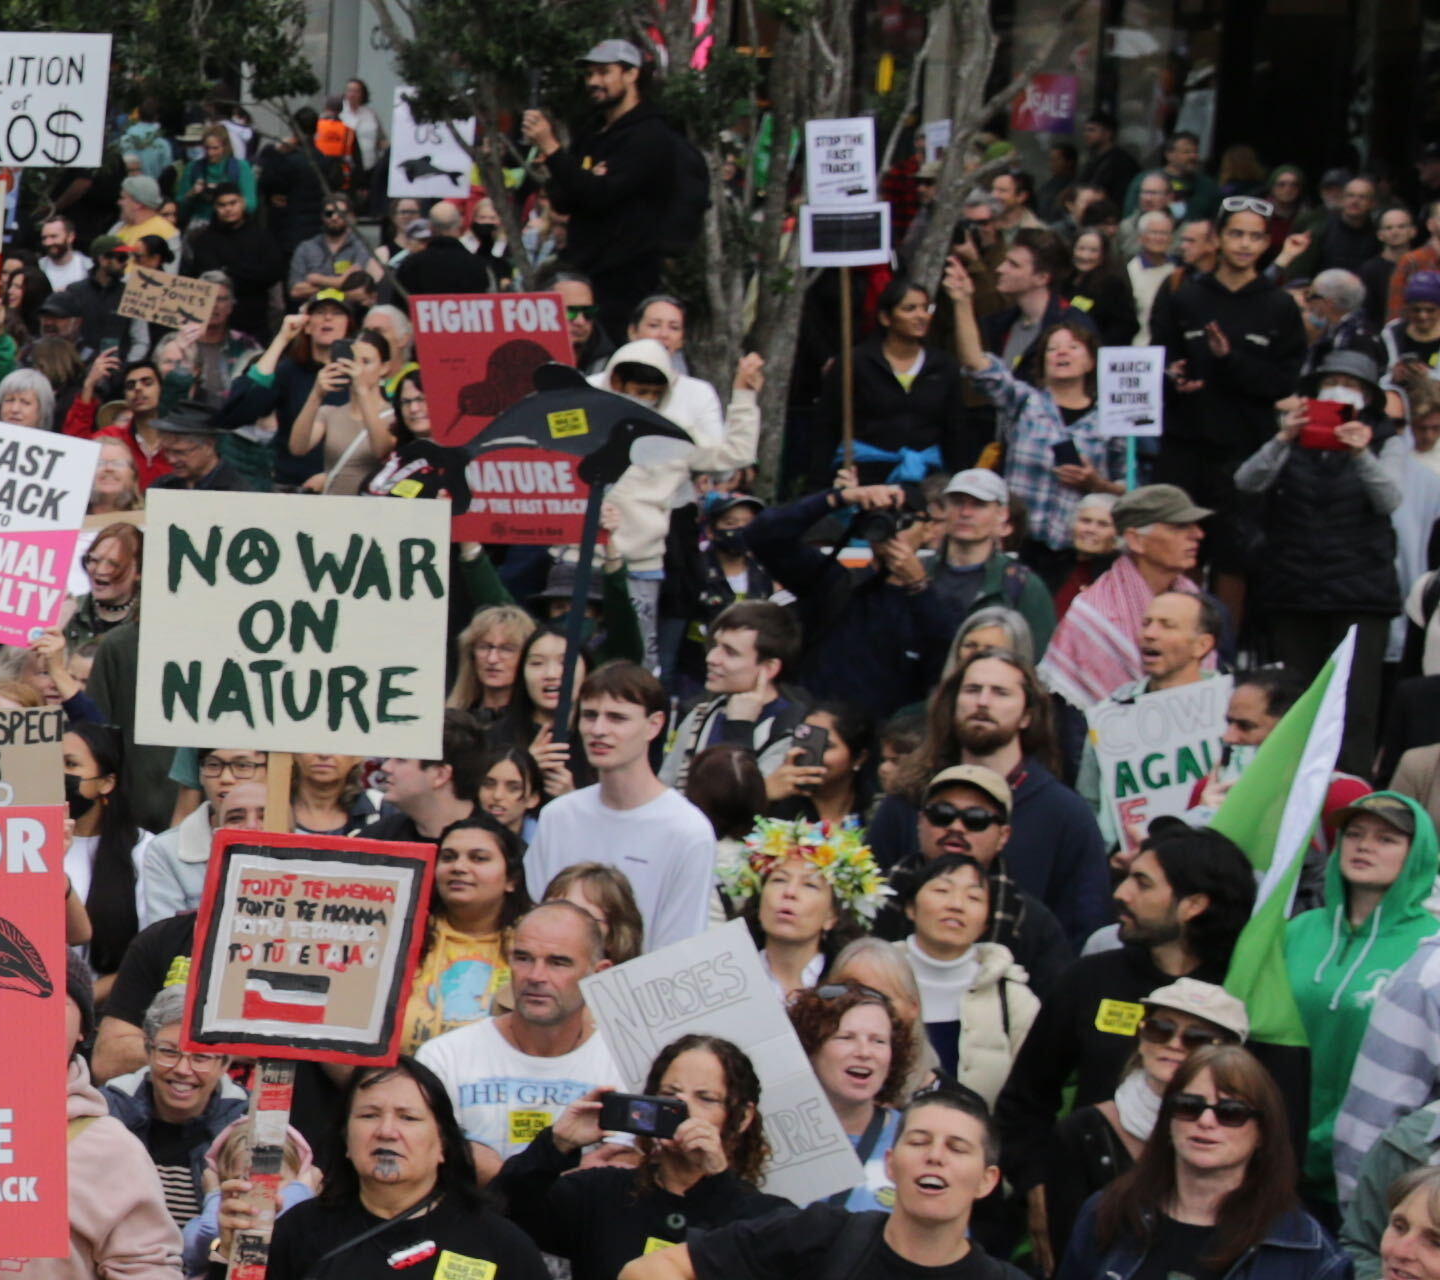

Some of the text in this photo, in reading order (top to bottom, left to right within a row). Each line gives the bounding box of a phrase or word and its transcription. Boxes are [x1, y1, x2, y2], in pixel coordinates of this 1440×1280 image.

[11, 94, 28, 112] of
[1031, 91, 1071, 119] SALE
[814, 134, 865, 149] STOP THE
[824, 148, 851, 161] FAST
[1109, 360, 1154, 374] MARCH
[1118, 375, 1142, 389] FOR
[1109, 390, 1151, 405] NATURE
[296, 530, 444, 600] WAR
[239, 599, 339, 654] ON
[161, 659, 420, 734] NATURE
[240, 877, 395, 904] TOITŪ TE WHENUA
[591, 950, 752, 1080] NURSES
